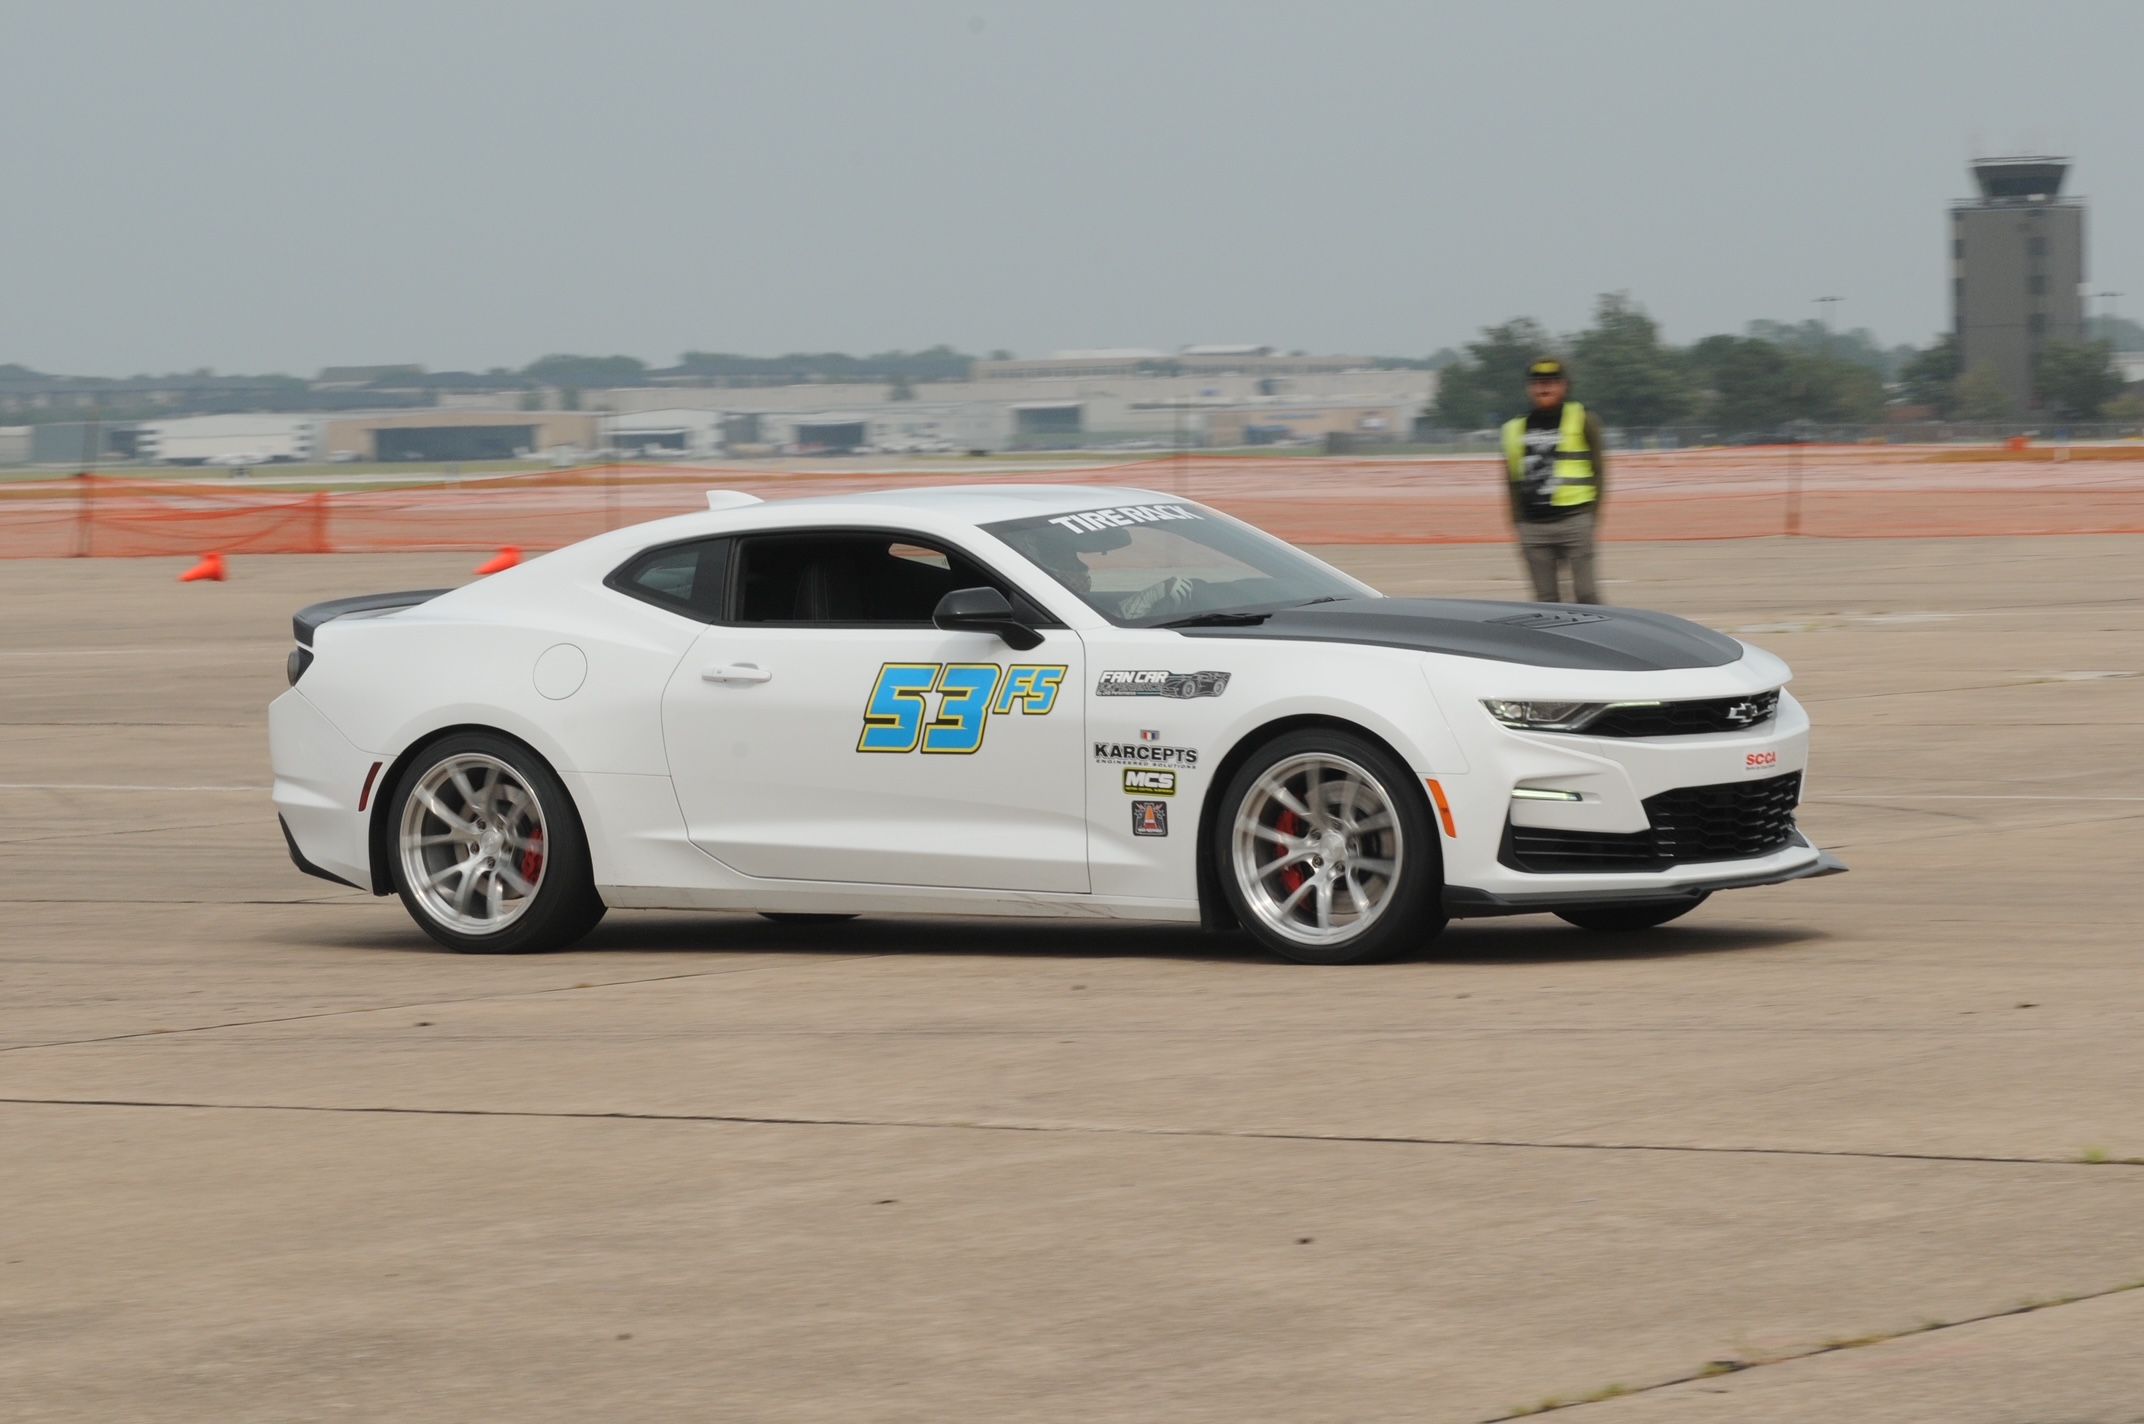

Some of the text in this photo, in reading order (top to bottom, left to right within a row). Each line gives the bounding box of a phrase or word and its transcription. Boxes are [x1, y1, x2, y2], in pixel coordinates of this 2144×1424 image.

[1100, 671, 1170, 683] FAN CAR
[856, 662, 1068, 754] 53 FS
[1095, 744, 1198, 763] KARCEPTS
[1746, 752, 1776, 765] SCCA
[1096, 759, 1149, 767] ENGINEERED
[1125, 771, 1174, 789] MCS
